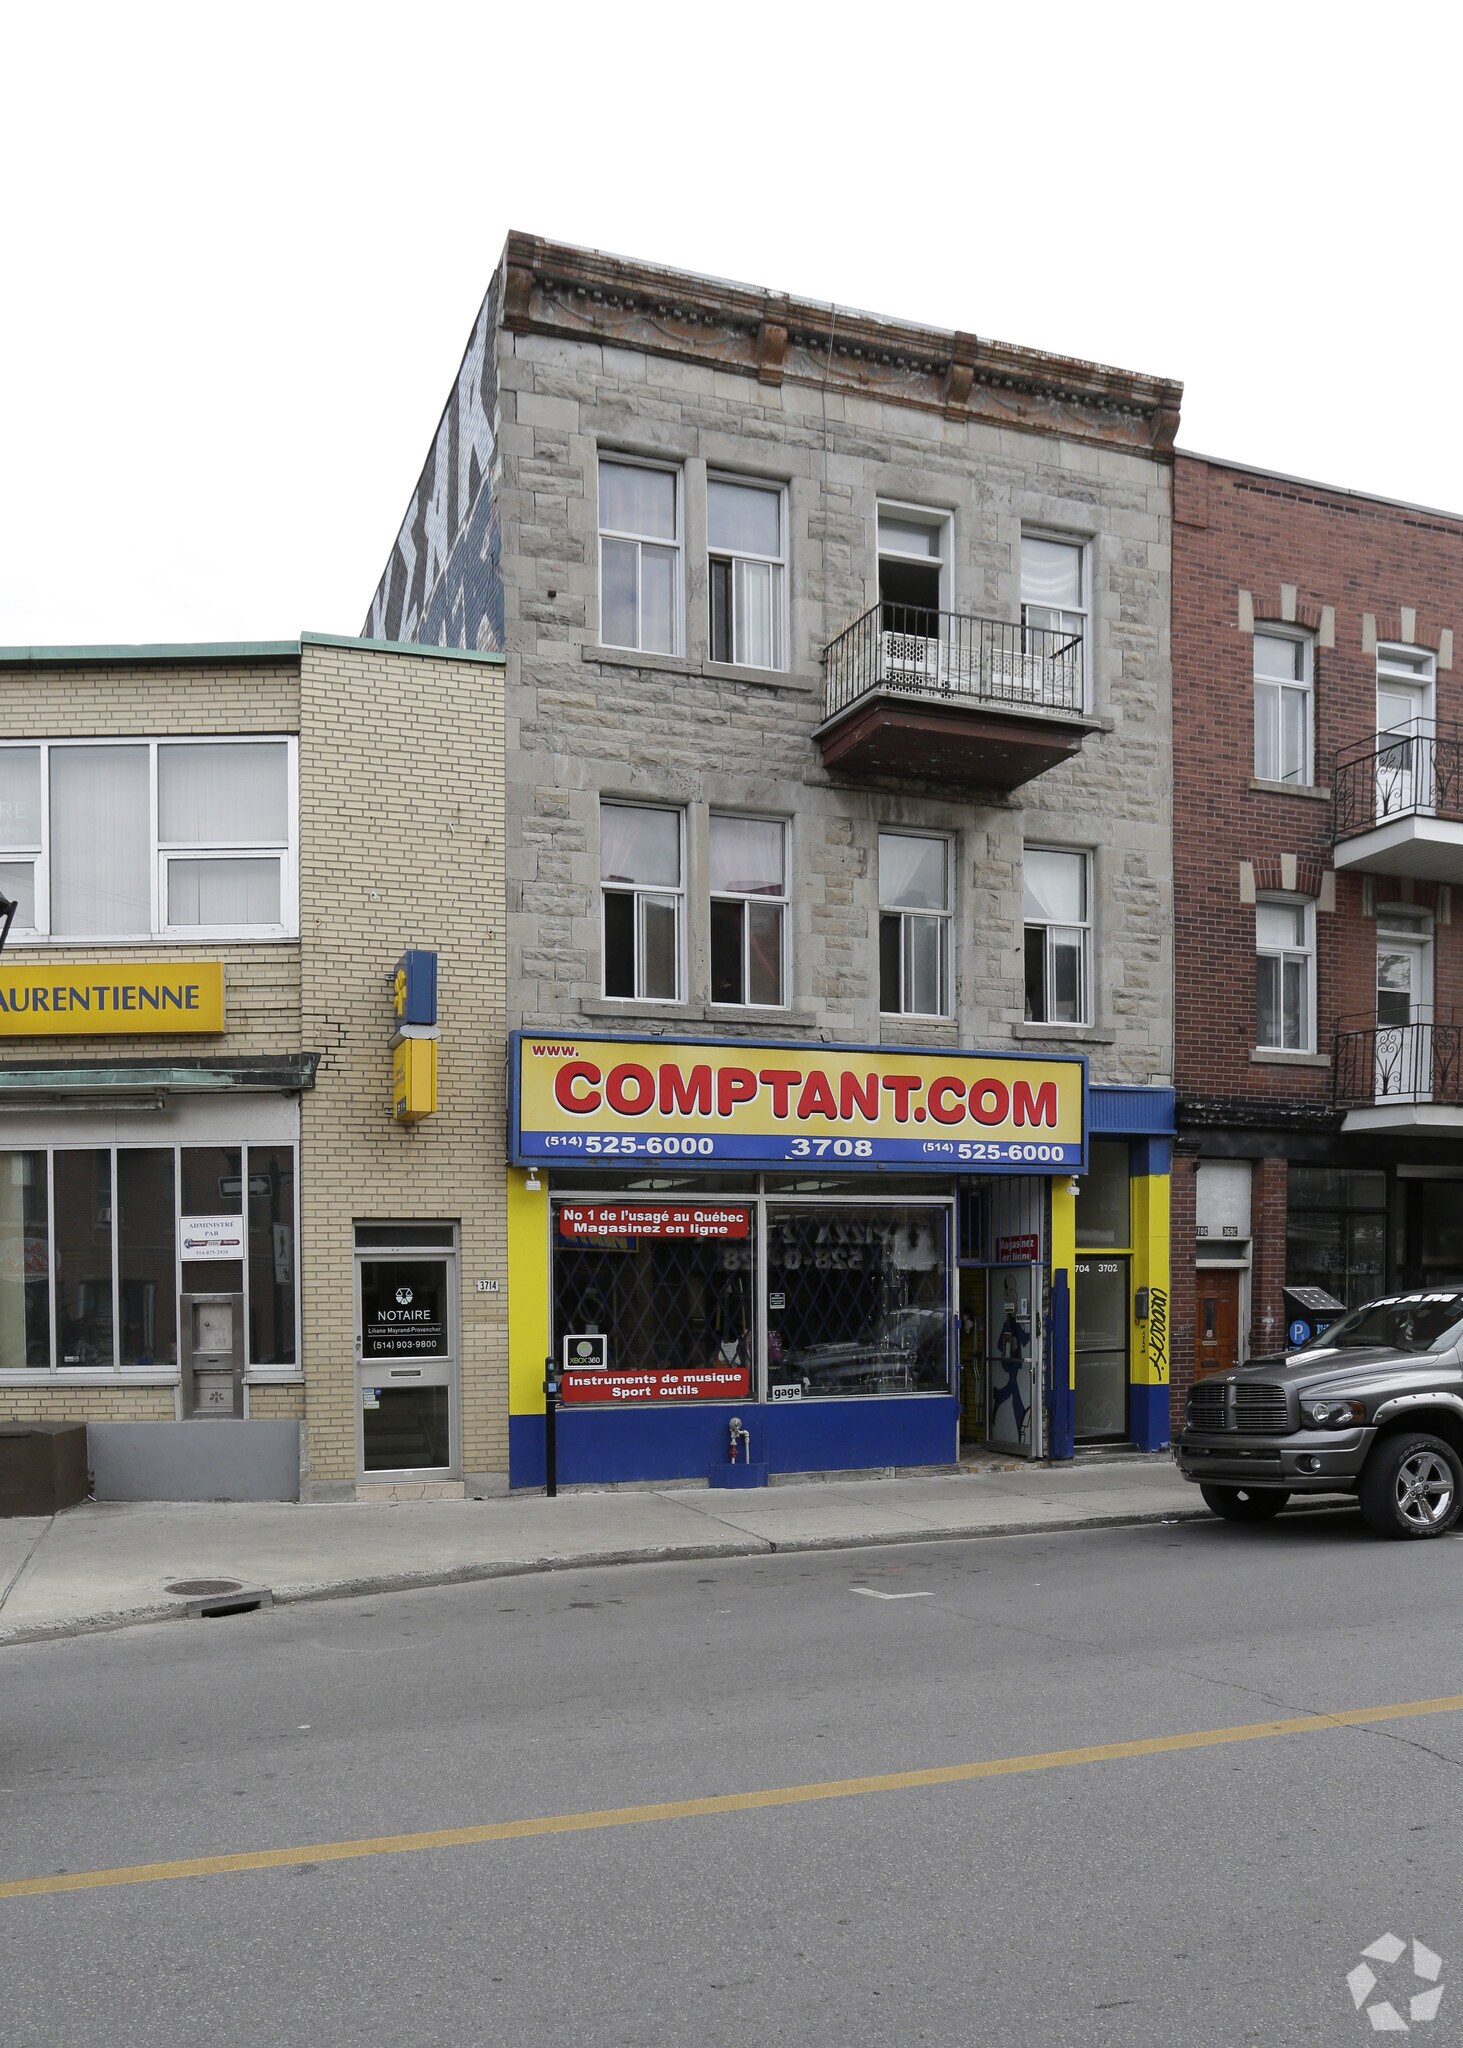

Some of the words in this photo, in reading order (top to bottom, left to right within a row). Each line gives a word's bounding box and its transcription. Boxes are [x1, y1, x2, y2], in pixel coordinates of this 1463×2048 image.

[532, 1045, 579, 1058] www.
[554, 1061, 1058, 1128] COMPTANT.COM
[545, 1135, 582, 1148] (514)
[585, 1137, 714, 1155] 525-6000
[791, 1138, 873, 1157] 3708
[922, 1142, 954, 1154] (514)
[957, 1144, 1064, 1161] 525-6000
[563, 1210, 583, 1220] No
[587, 1211, 594, 1220] 1
[599, 1210, 617, 1221] de
[673, 1213, 690, 1222] au
[693, 1211, 744, 1223] Québec
[189, 1221, 235, 1229] ADMINISTRÉ
[573, 1222, 661, 1234] Magasinez
[690, 1223, 728, 1235] ligne
[1098, 1263, 1118, 1273] 3702
[480, 1281, 497, 1290] 3714
[1371, 1294, 1458, 1308] RAM
[378, 1310, 431, 1320] NOTAIRE
[387, 1327, 441, 1335] Mayrand-Provencher
[373, 1341, 395, 1350] (514)
[396, 1340, 437, 1349] 903-9800
[569, 1375, 657, 1386] Instruments
[661, 1373, 678, 1383] de
[683, 1372, 741, 1384] musique
[612, 1386, 651, 1398] Sport
[659, 1385, 699, 1395] outils
[774, 1387, 800, 1399] gage
